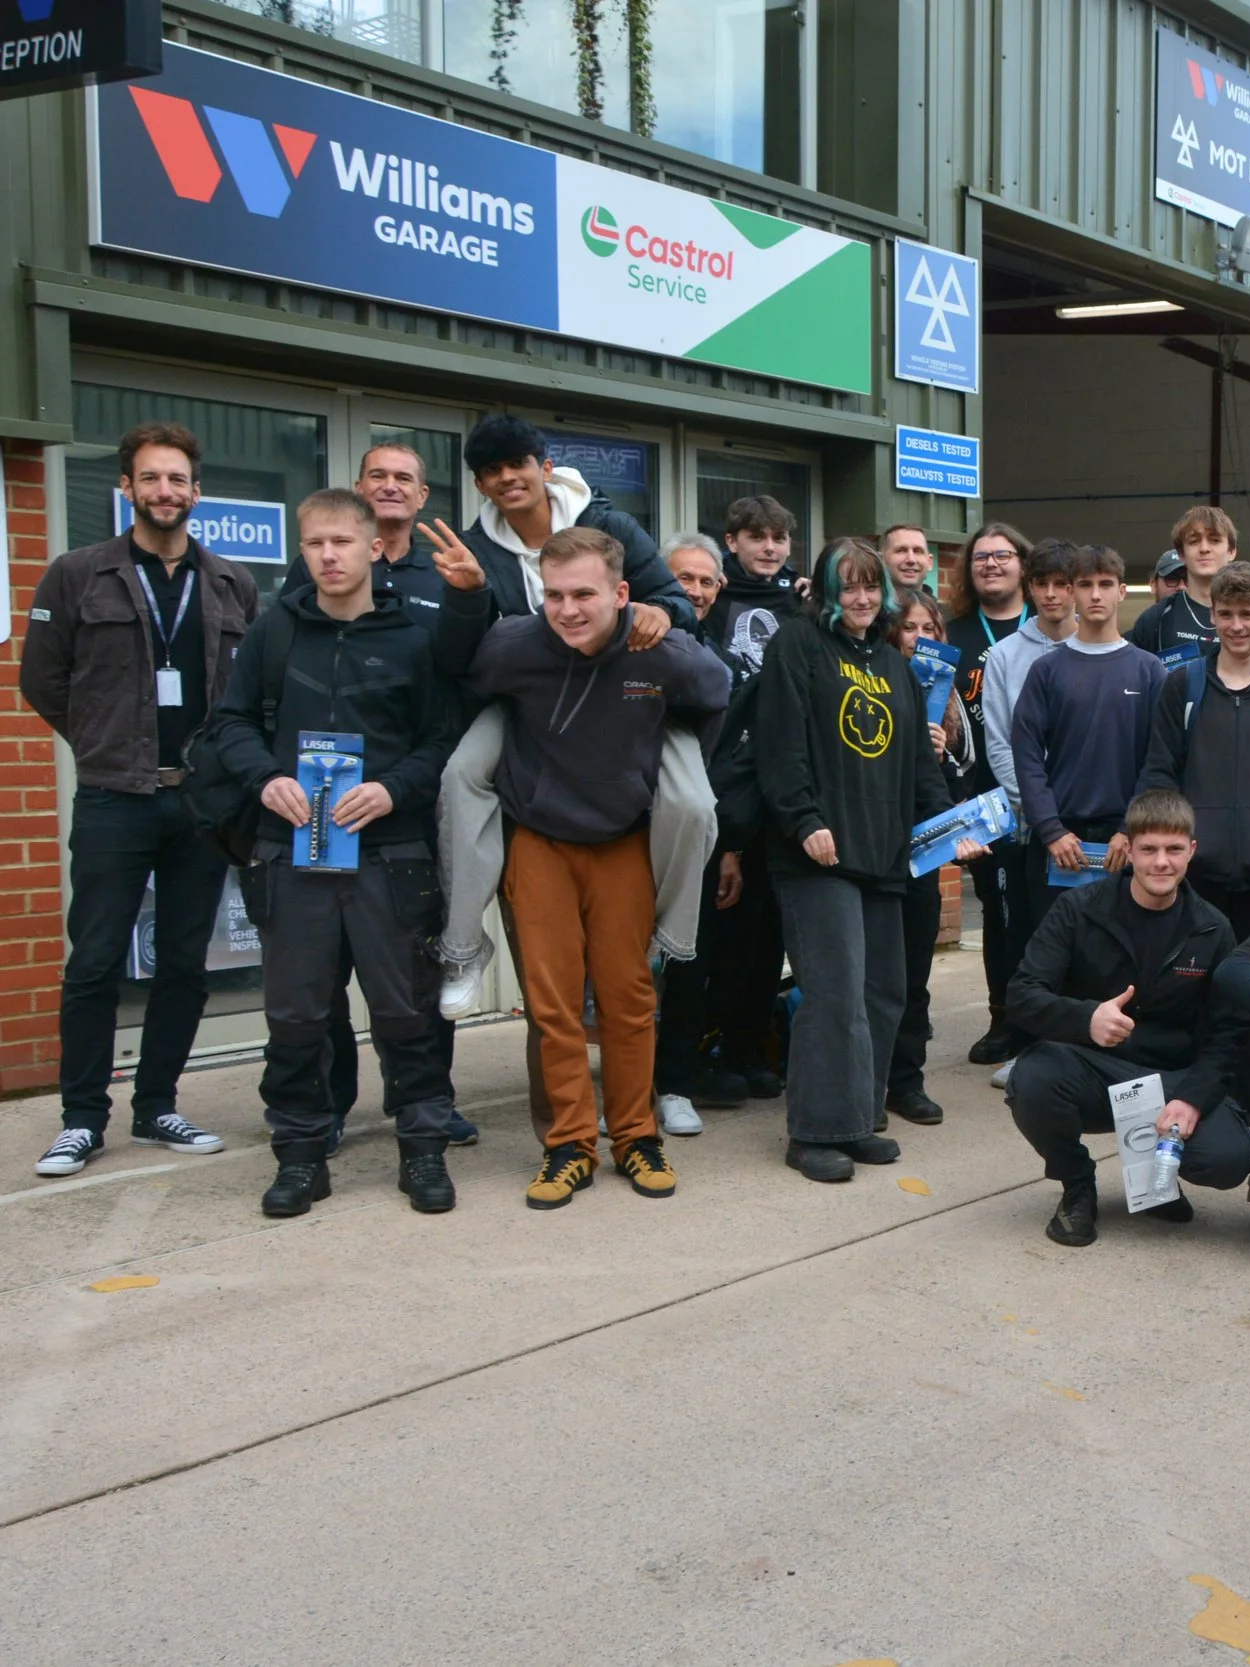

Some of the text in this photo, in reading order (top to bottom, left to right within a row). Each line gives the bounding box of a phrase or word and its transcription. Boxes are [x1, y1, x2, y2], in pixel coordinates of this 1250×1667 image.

[0, 28, 82, 71] EPTION
[1209, 140, 1246, 178] MOT
[329, 141, 535, 236] Williams
[373, 215, 499, 267] GARAGE
[624, 225, 734, 281] Castrol
[627, 265, 707, 304] Service
[905, 437, 971, 457] DIESELS TESTED
[900, 466, 976, 486] CATALYSTS TESTED
[1176, 632, 1199, 640] TOMMY
[916, 644, 940, 657] LASER
[1161, 653, 1182, 664] LASER
[303, 740, 335, 750] LASER
[229, 909, 248, 919] CHE
[229, 929, 259, 941] VEHIC
[230, 940, 261, 952] INSPE
[1115, 1089, 1139, 1102] LASER
